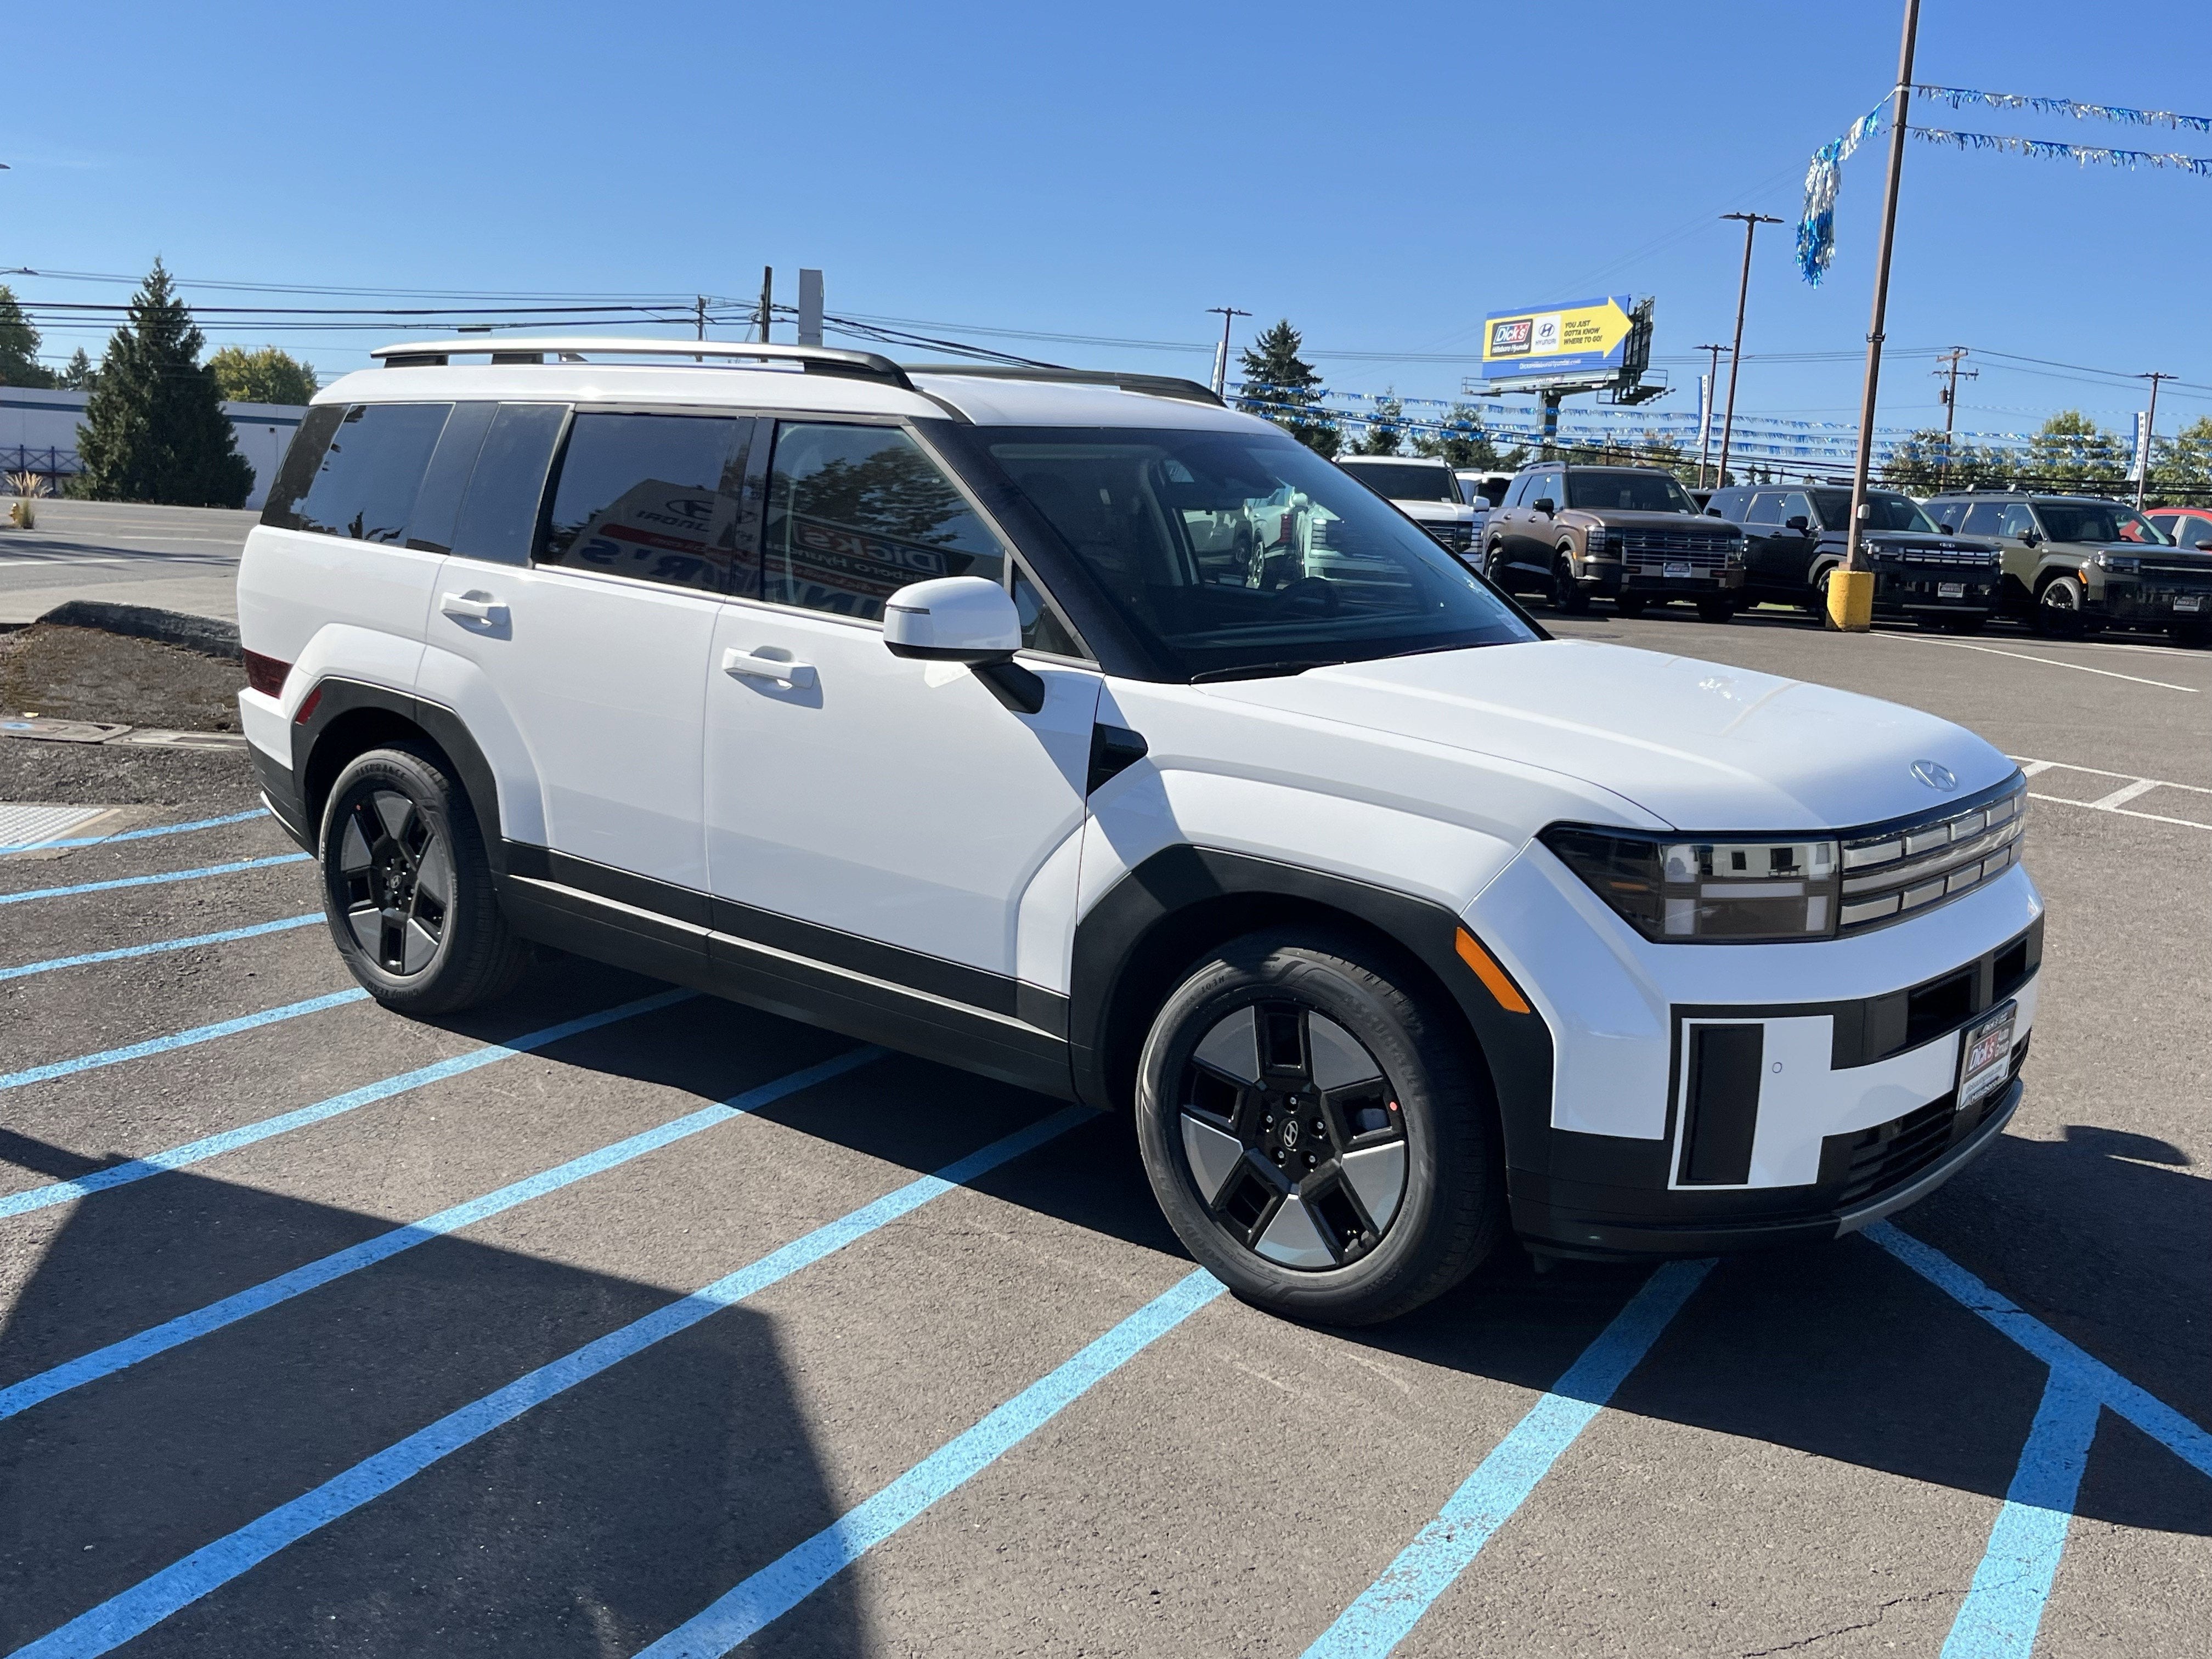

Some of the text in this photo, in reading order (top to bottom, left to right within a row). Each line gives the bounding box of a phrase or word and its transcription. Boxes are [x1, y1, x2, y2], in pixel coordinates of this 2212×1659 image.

[1496, 325, 1526, 342] Dick's
[1583, 327, 1600, 335] KNOW
[1564, 337, 1583, 345] WHERE
